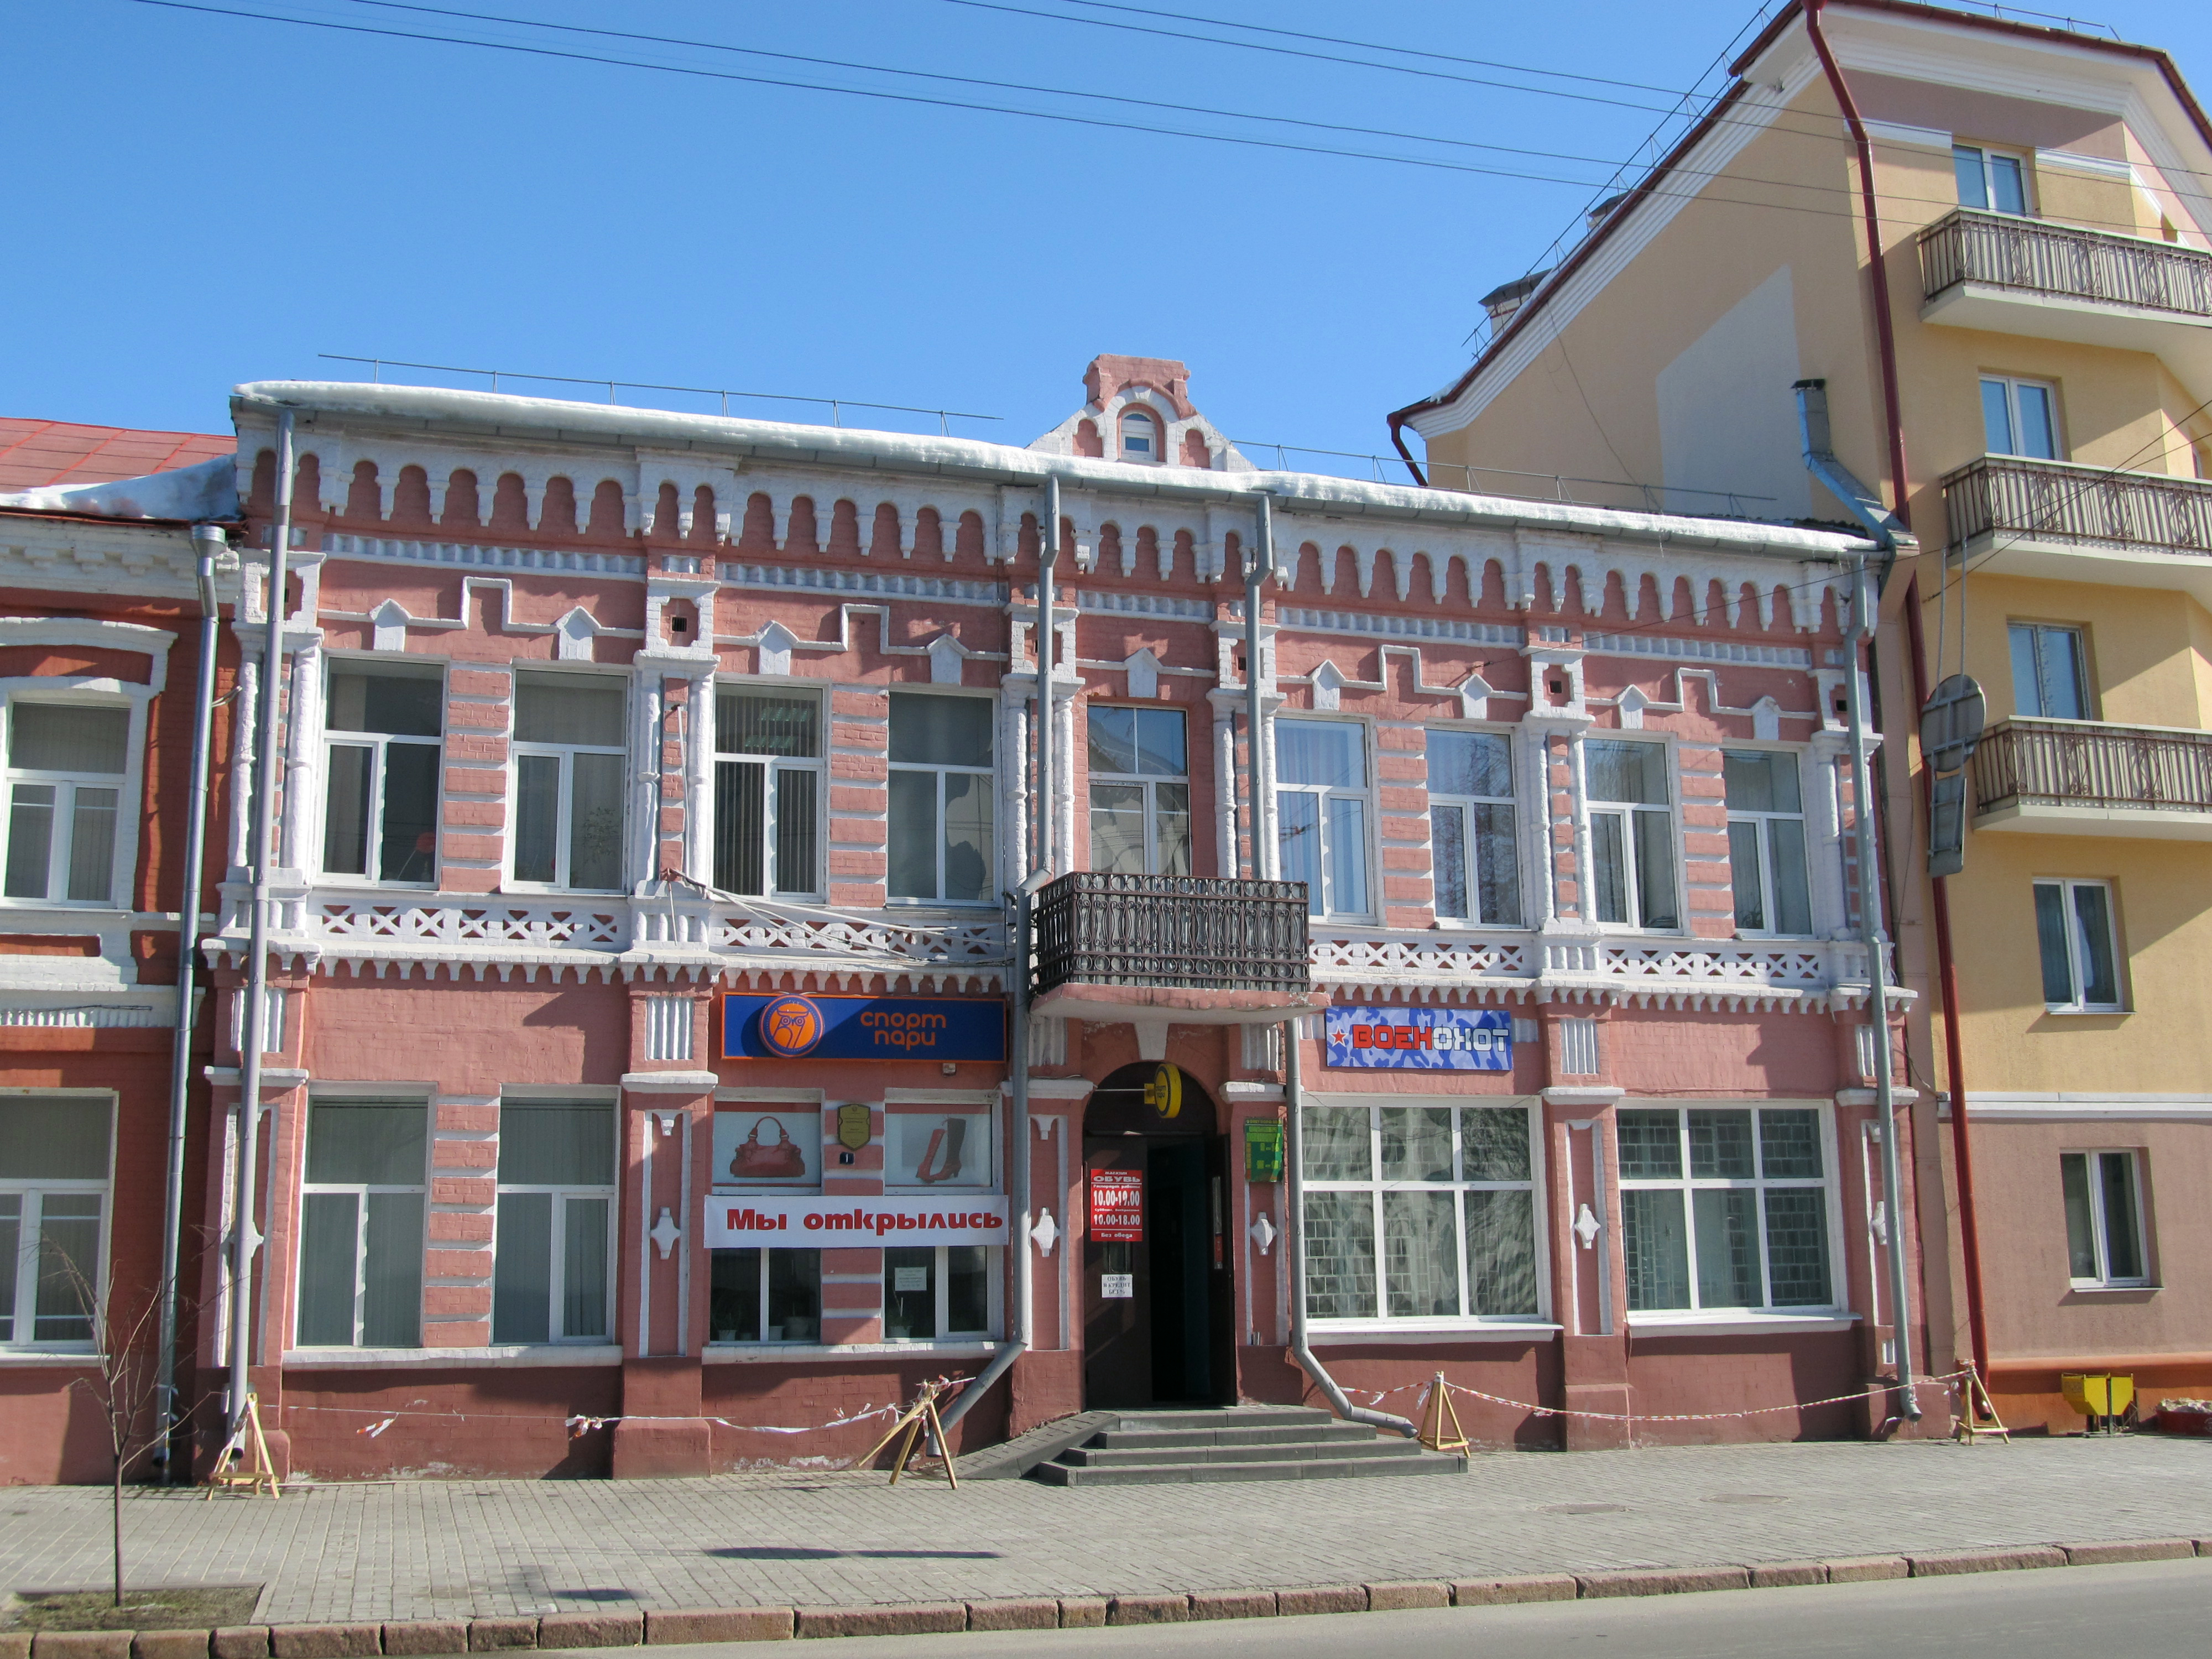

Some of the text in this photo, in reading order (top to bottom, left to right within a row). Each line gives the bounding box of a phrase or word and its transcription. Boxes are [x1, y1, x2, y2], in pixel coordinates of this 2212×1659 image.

[860, 1011, 946, 1030] спорт
[874, 1030, 936, 1051] пари
[1353, 1024, 1509, 1052] ВОЕНОХОТ
[1093, 1190, 1140, 1206] 10.00-19.00
[727, 1209, 1003, 1235] Мы открылись
[1094, 1214, 1140, 1225] 10.00-18.00
